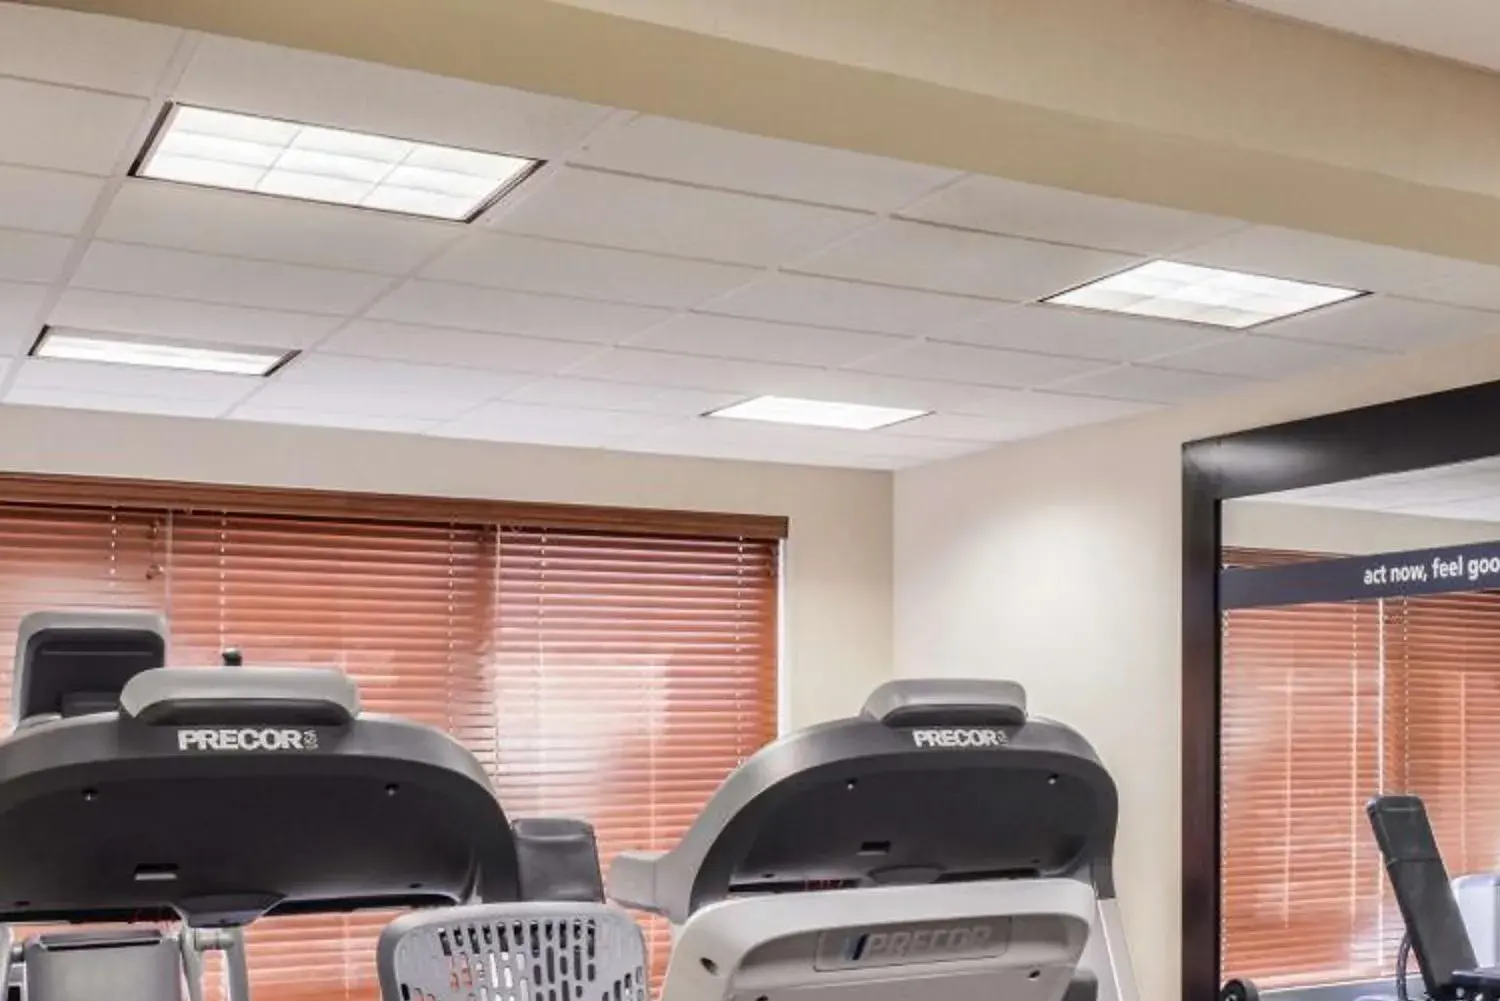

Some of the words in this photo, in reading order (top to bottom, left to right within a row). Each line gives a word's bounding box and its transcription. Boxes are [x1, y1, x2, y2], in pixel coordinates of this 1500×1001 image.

[1363, 565, 1387, 585] act
[1390, 564, 1428, 583] now,
[1431, 555, 1464, 579] feel
[177, 728, 304, 750] PRECOR
[912, 729, 1000, 748] PRECOR
[863, 926, 992, 957] PRECOR
